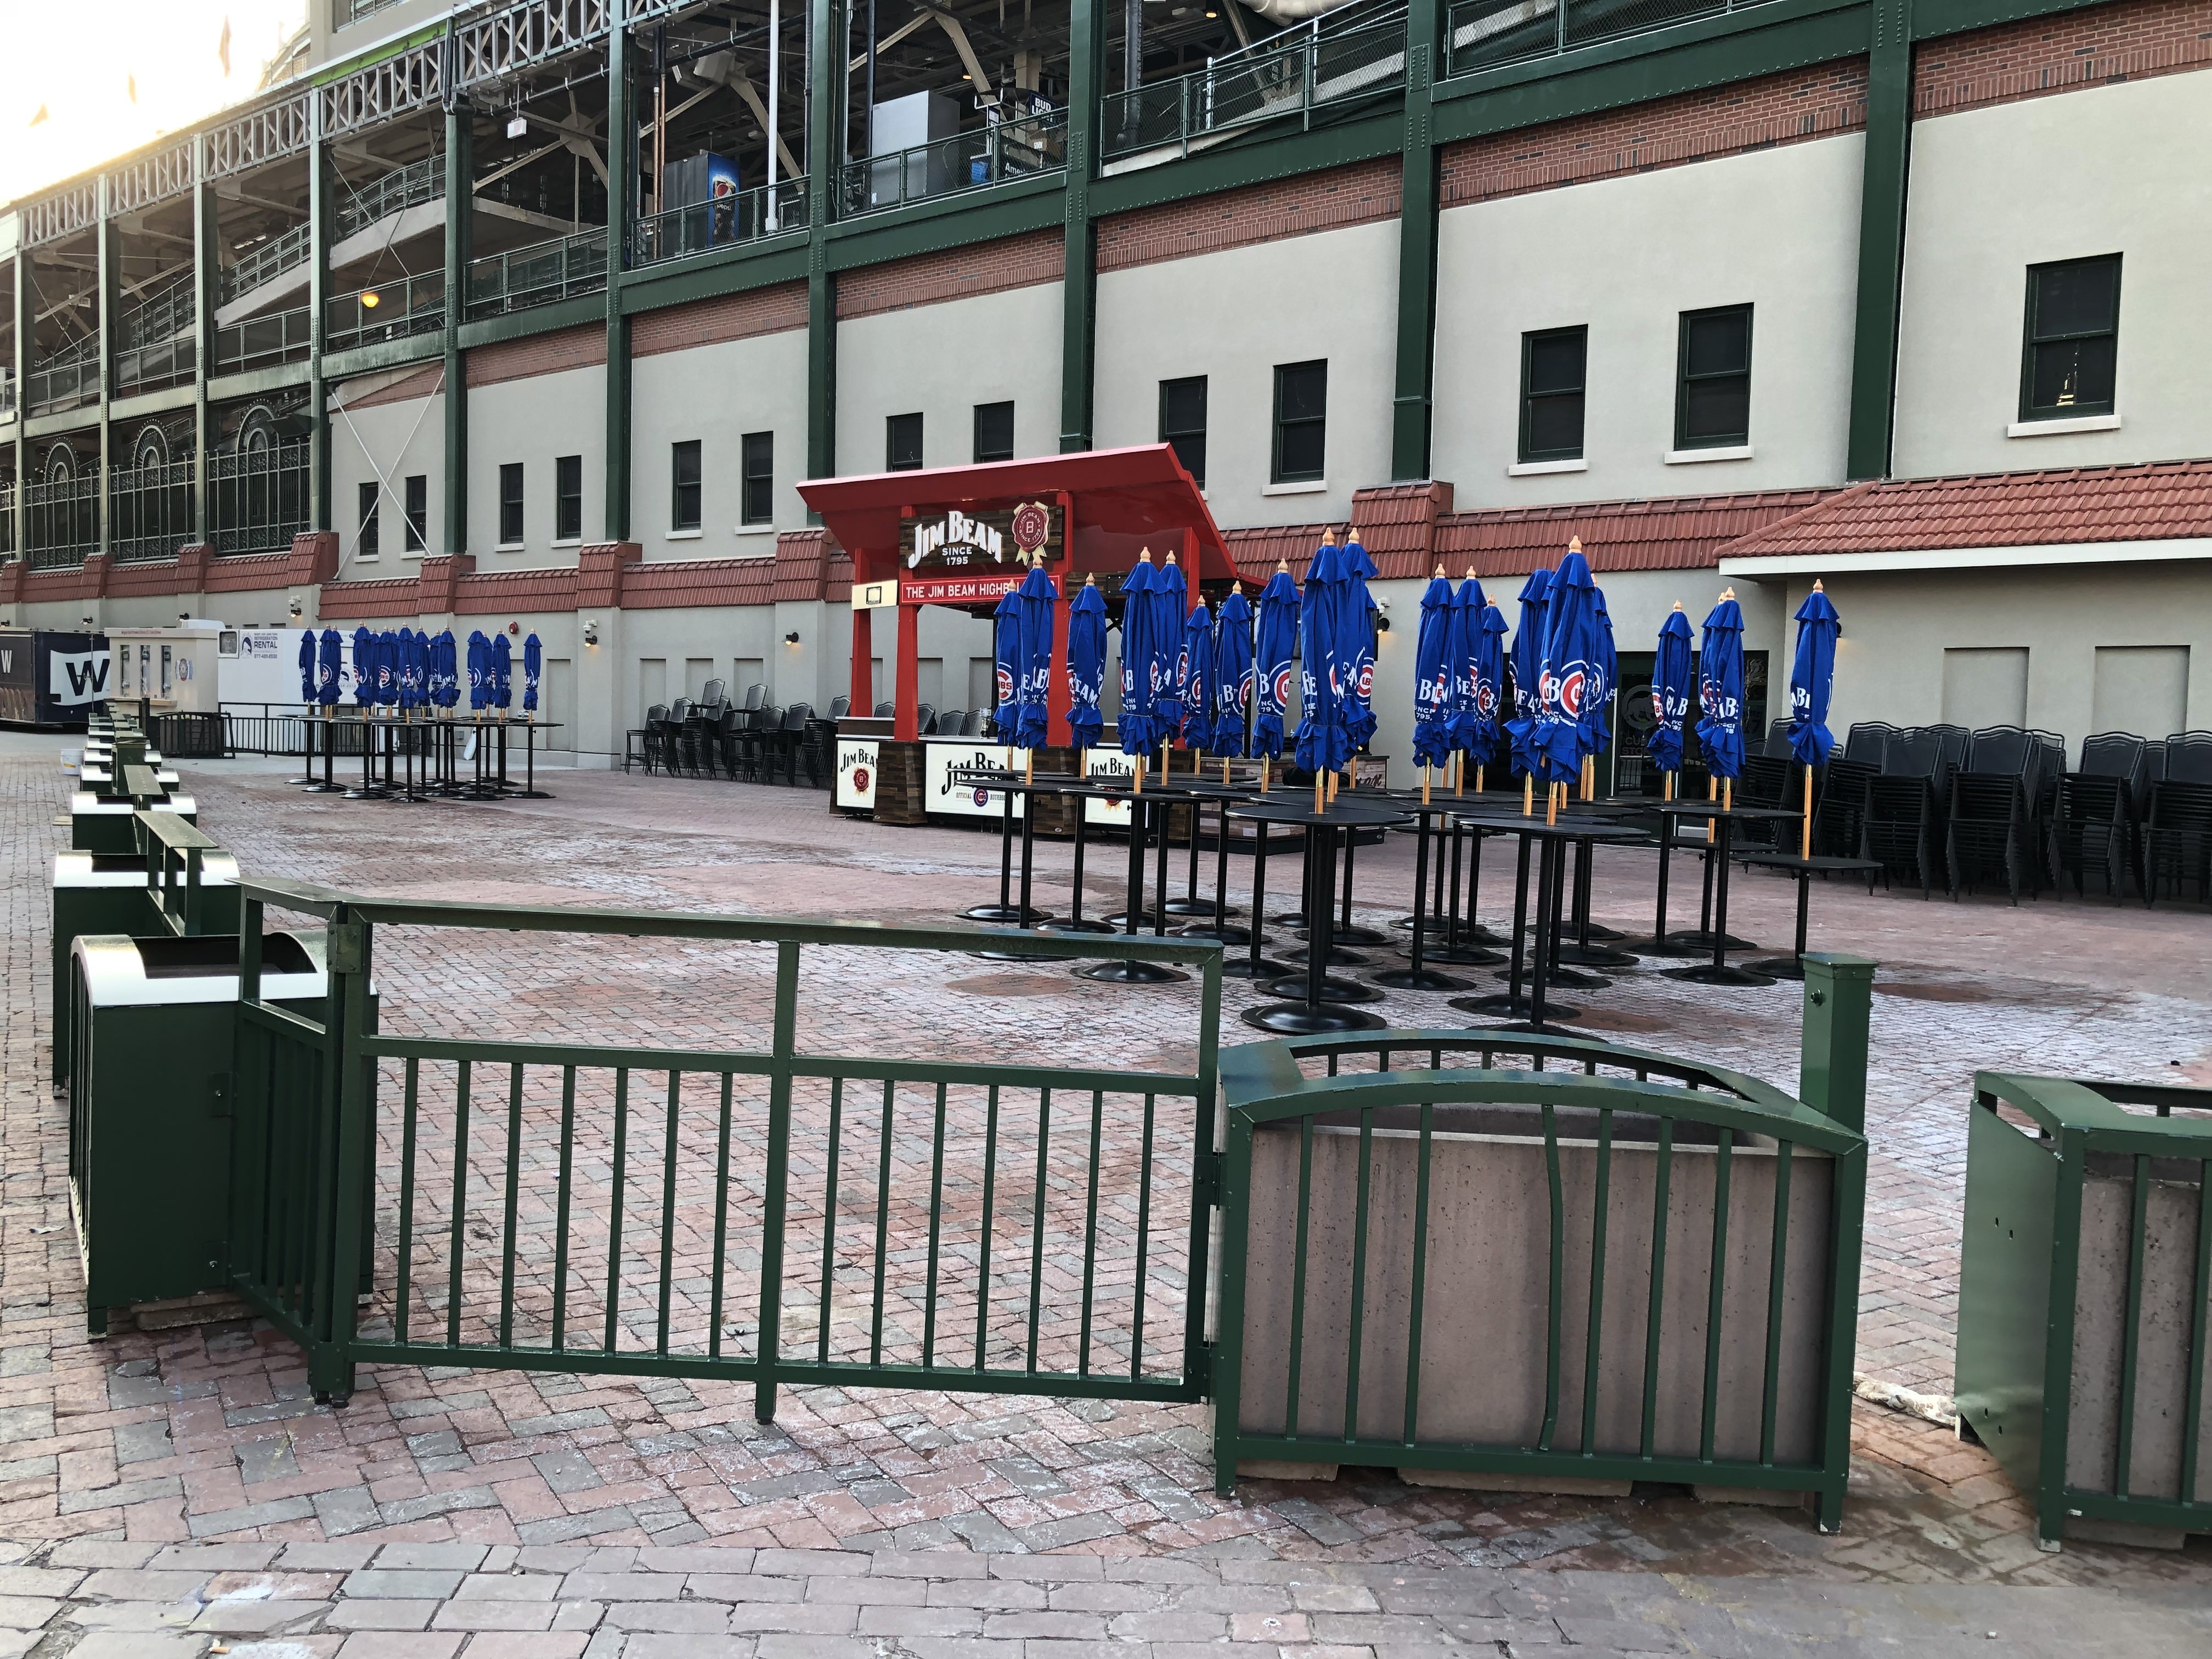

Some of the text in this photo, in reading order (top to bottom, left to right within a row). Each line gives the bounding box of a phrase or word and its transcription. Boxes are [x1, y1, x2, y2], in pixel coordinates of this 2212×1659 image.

[1035, 97, 1052, 111] BUD
[1026, 521, 1034, 534] B
[908, 511, 1003, 569] JIM BEAM
[942, 546, 973, 556] SINCE
[946, 556, 969, 566] 1795
[906, 582, 1019, 599] THE JIM BEAM HIGHBL
[65, 658, 110, 696] W
[840, 748, 878, 772] JIM BEA
